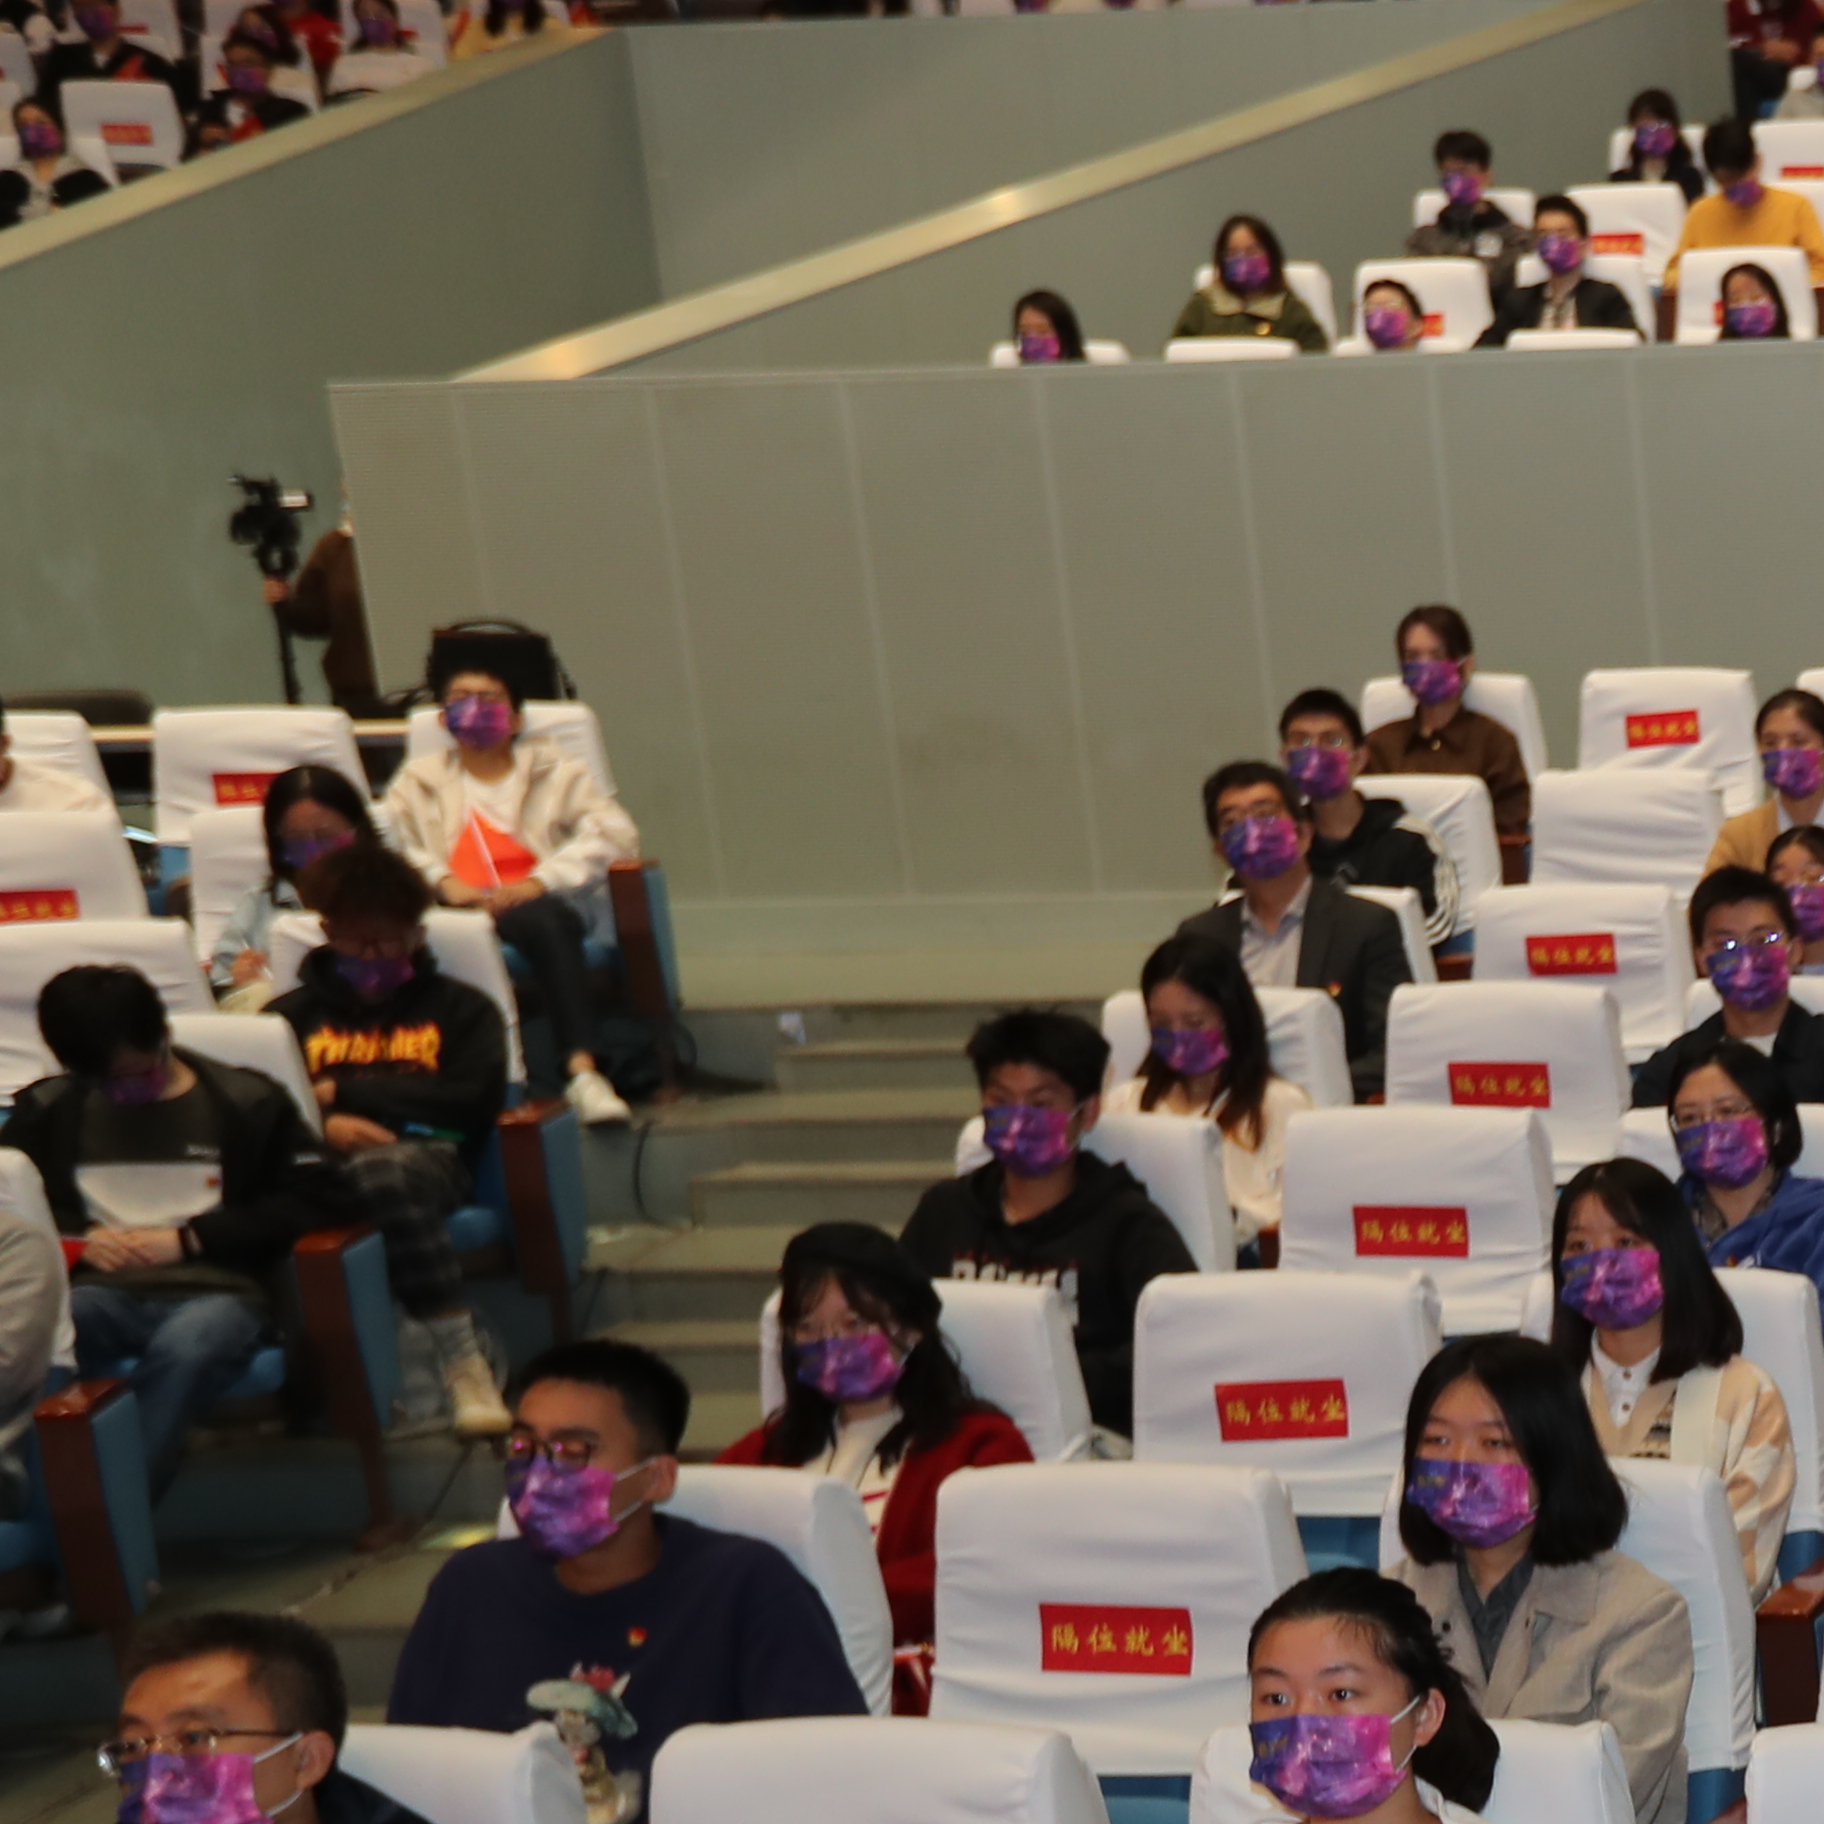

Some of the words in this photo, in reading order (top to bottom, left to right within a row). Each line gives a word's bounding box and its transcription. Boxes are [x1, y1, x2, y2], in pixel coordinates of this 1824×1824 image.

[1360, 1220, 1466, 1245] 隔位就坐
[1225, 1396, 1346, 1425] 隔位就坐
[1051, 1623, 1190, 1657] 隔位就坐
